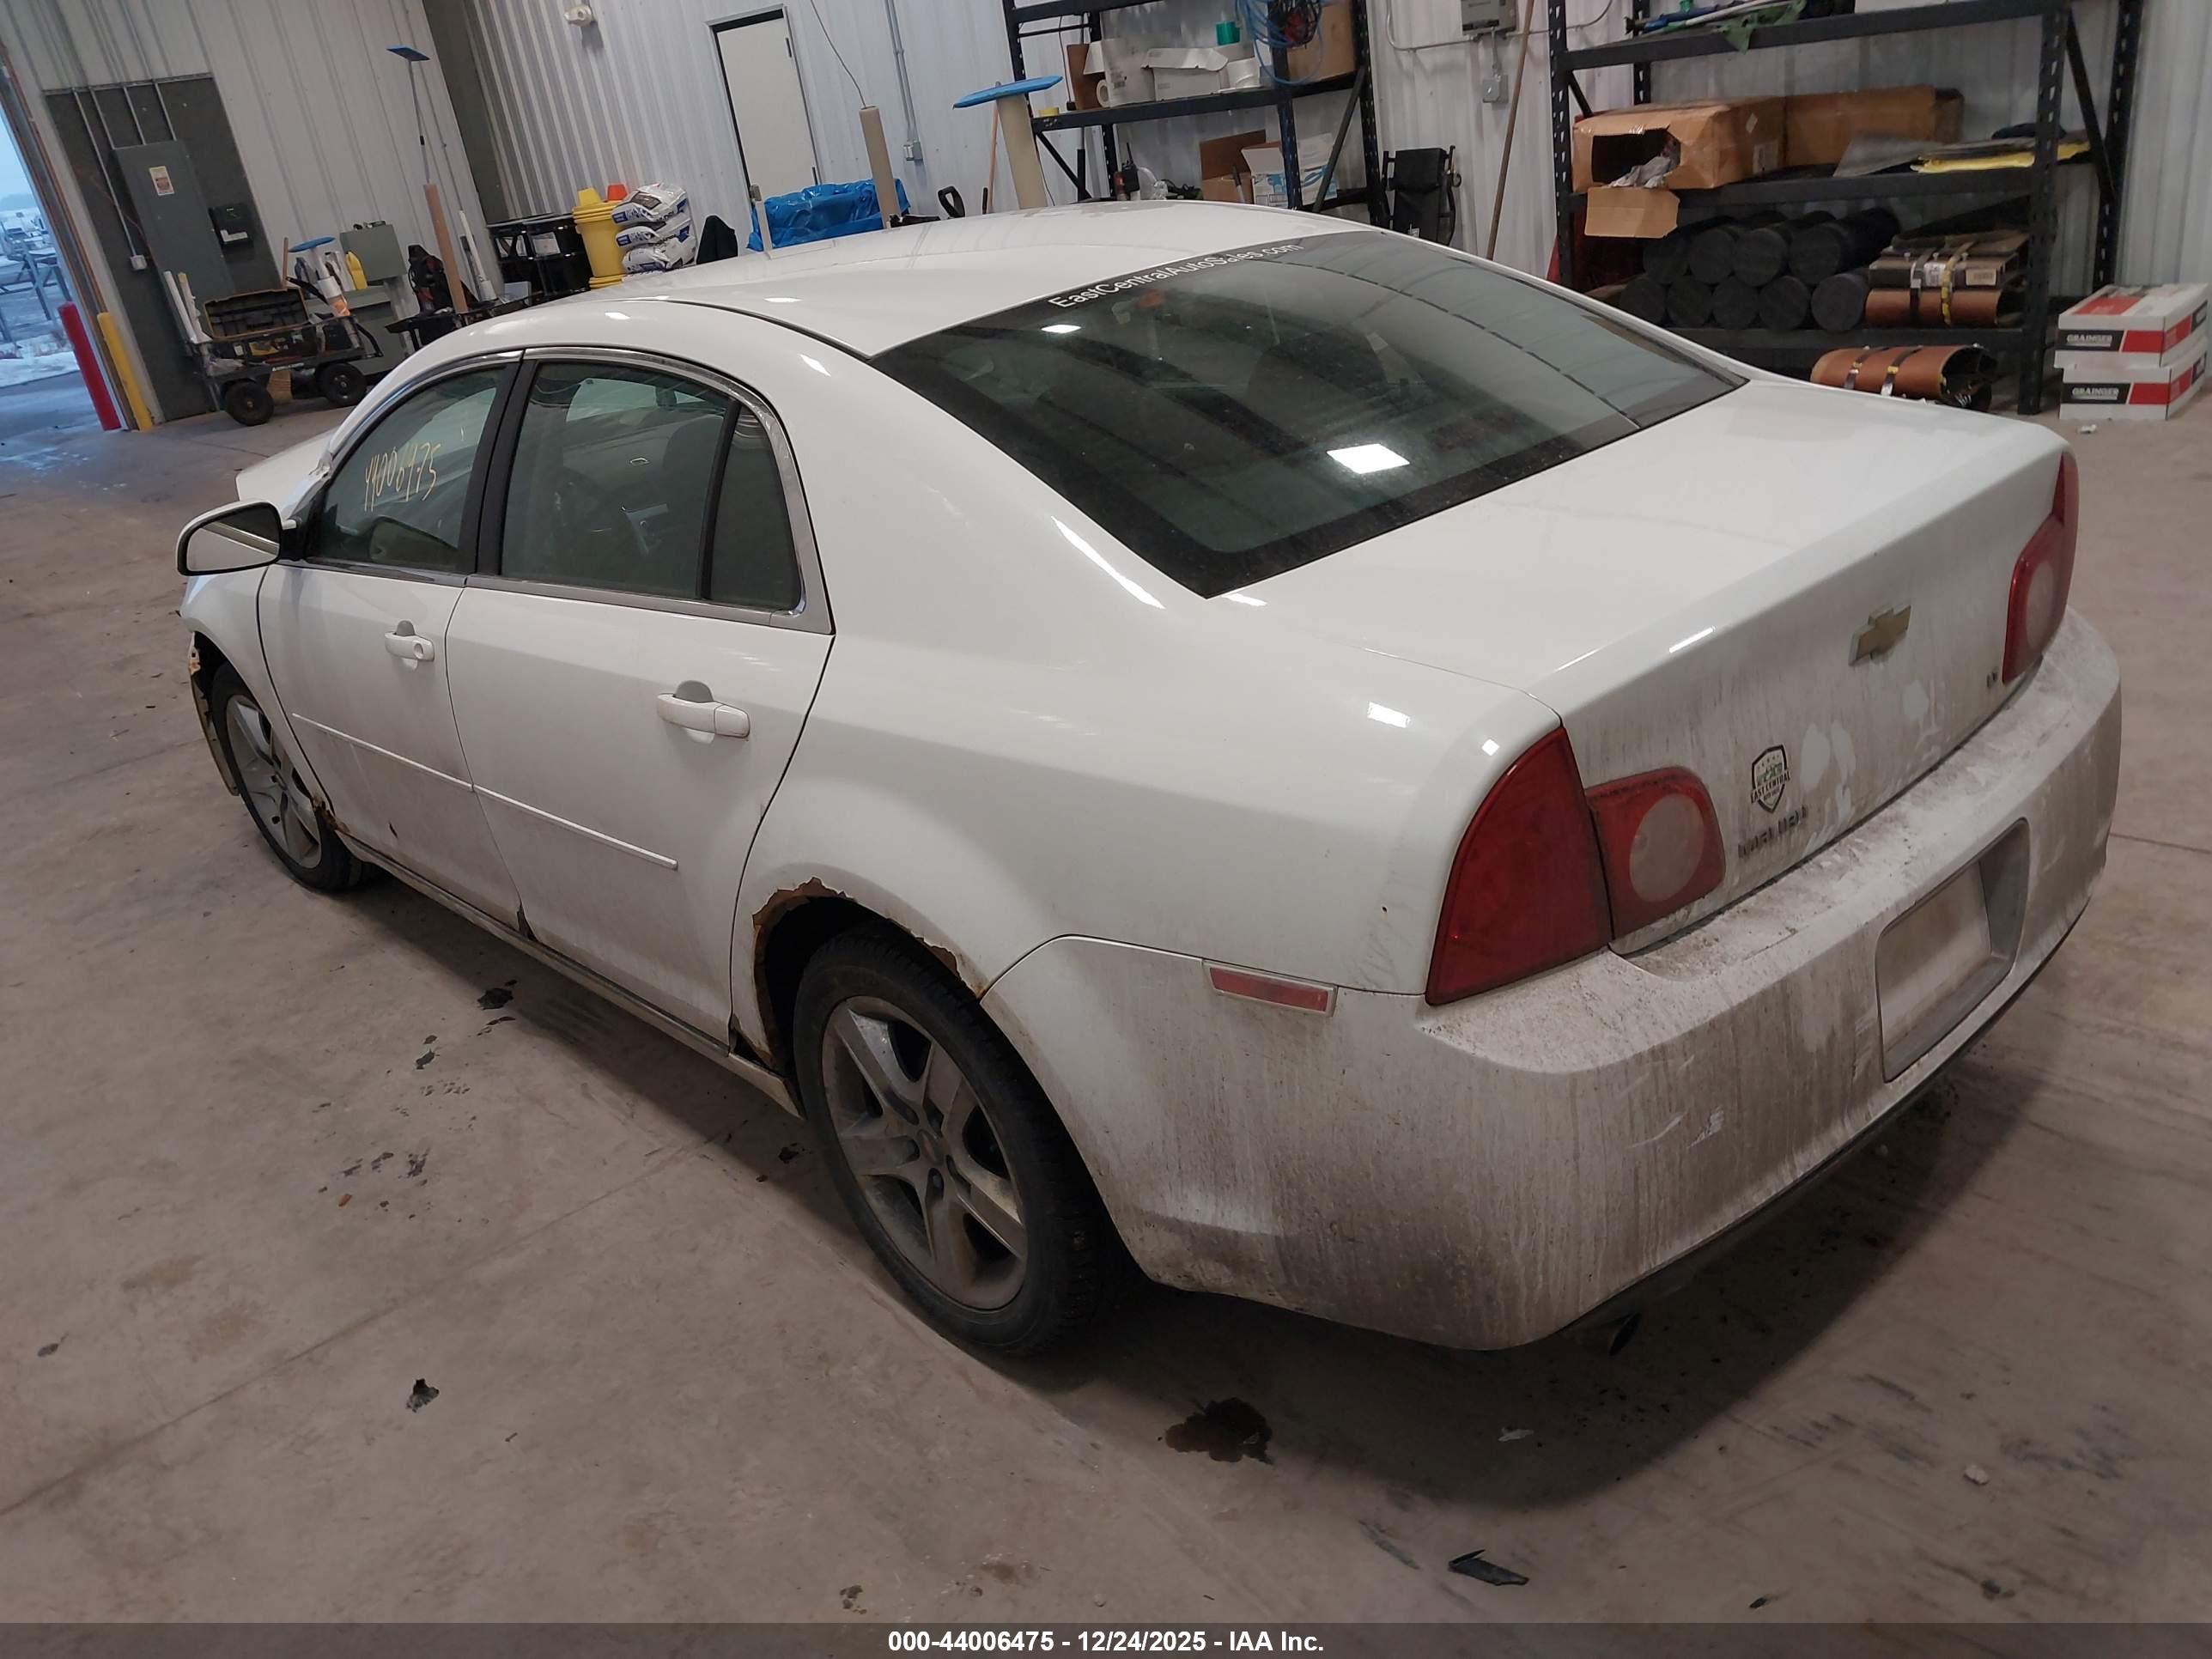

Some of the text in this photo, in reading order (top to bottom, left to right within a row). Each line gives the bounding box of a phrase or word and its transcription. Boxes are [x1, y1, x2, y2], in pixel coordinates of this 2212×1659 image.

[1048, 243, 1304, 307] EastCentralAutoSales.com
[2066, 334, 2112, 343] GRAINGER
[2072, 387, 2119, 396] GRAINGER
